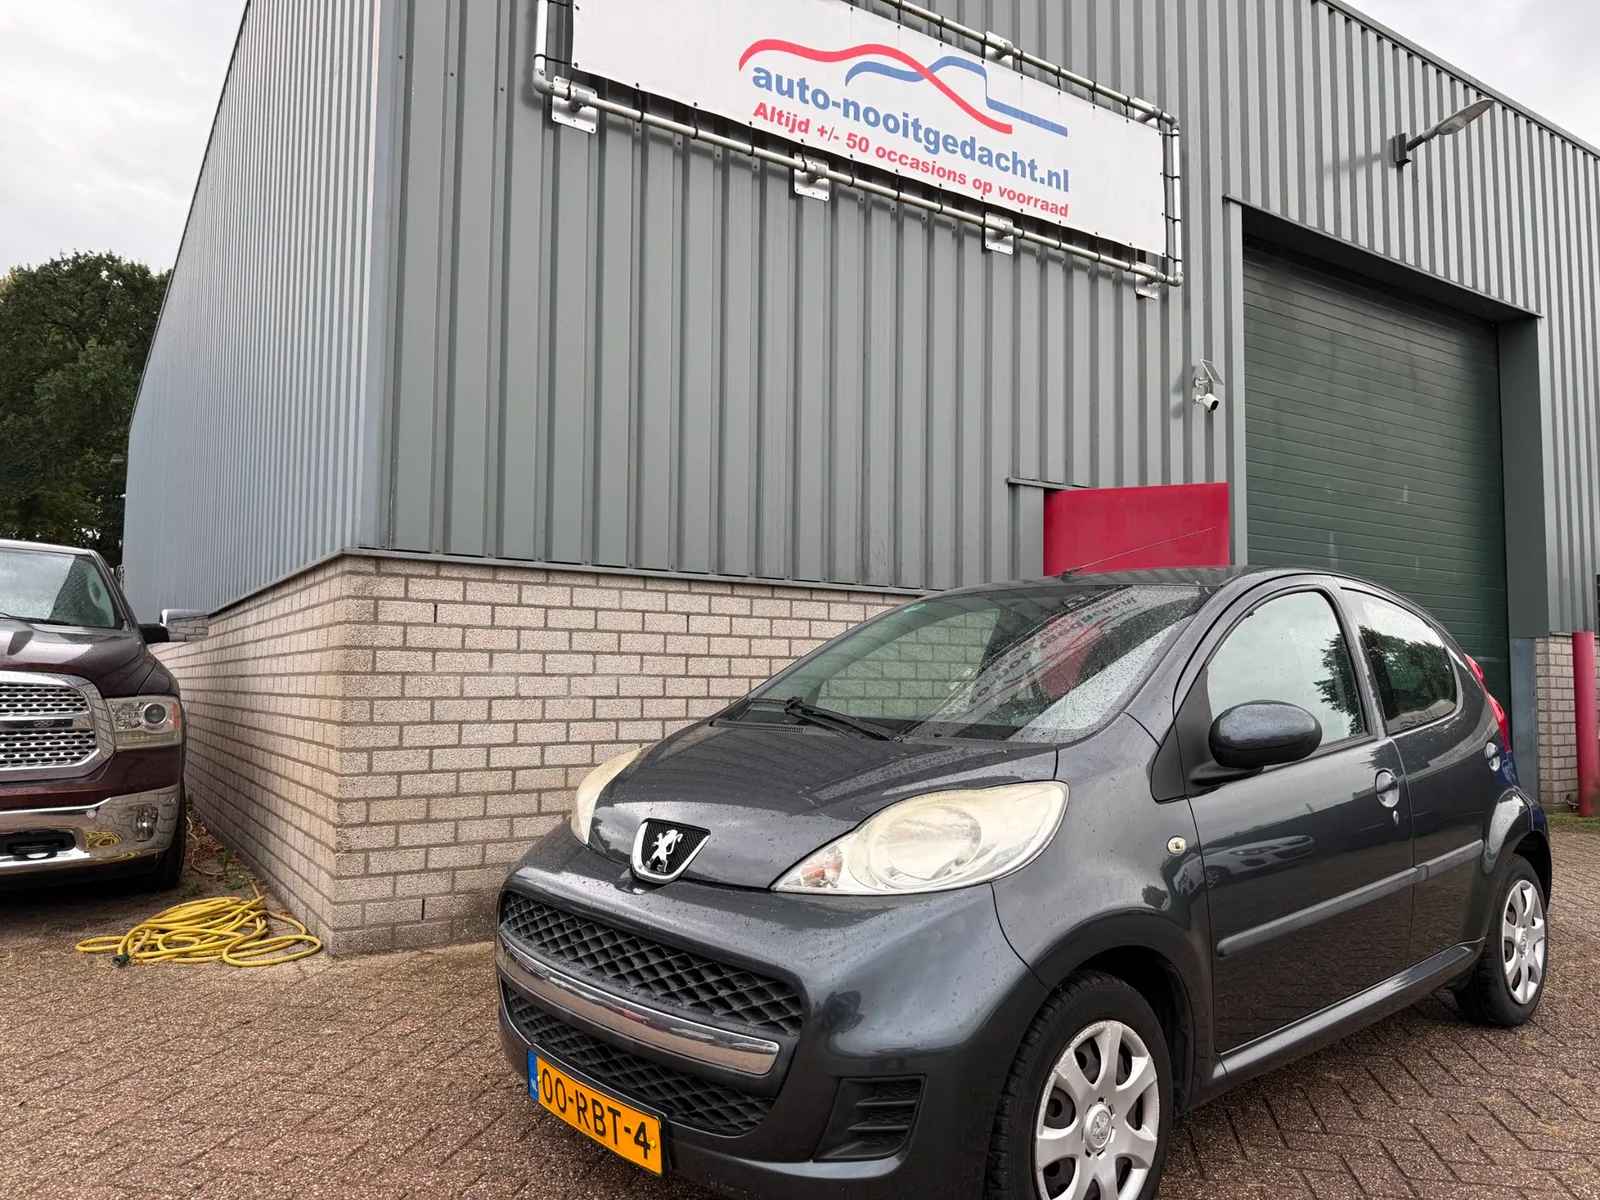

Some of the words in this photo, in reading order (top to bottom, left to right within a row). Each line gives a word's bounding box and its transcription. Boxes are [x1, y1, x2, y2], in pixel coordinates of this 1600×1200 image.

[752, 66, 1069, 193] auto-nooitgedacht.nl
[753, 102, 811, 134] Altijd
[817, 125, 840, 142] +/-
[845, 132, 870, 153] 50
[875, 146, 967, 185] occasions
[972, 178, 993, 195] op
[998, 185, 1069, 218] voorraad
[542, 1068, 651, 1160] 00-RBT-4
